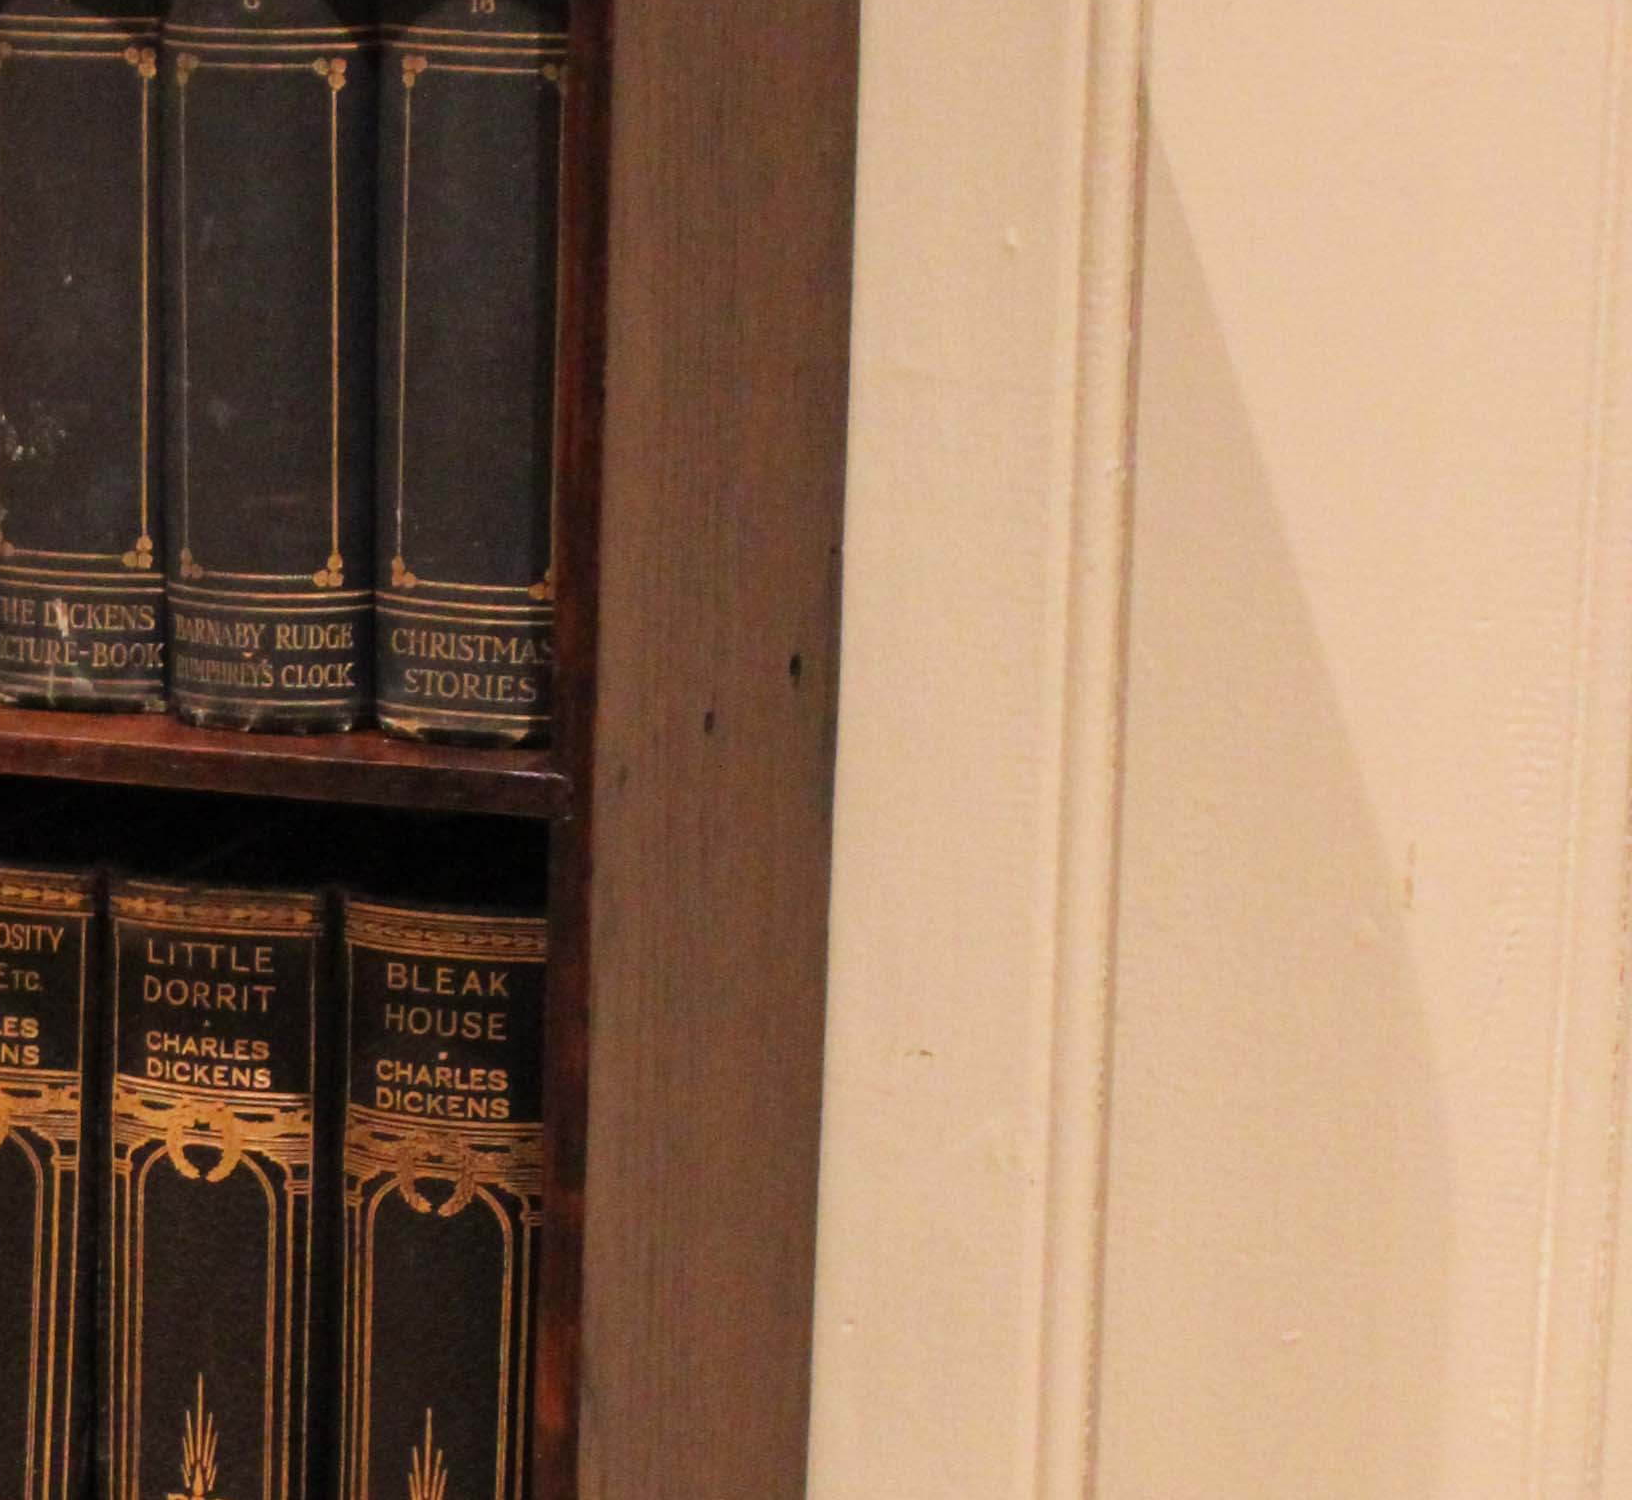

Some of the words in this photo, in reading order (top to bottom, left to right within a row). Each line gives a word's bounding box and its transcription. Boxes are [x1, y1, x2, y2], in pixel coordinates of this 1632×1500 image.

[43, 599, 156, 631] DICKENS
[175, 614, 265, 650] BARNABY
[275, 623, 354, 651] RUDGE
[280, 662, 355, 688] CLOCK
[405, 668, 536, 702] STORIES
[146, 939, 275, 973] LITTLE
[143, 974, 277, 1013] DORRIT
[386, 961, 510, 997] BLEAK
[384, 1003, 507, 1041] HOUSE
[145, 1030, 270, 1061] CHARLES
[146, 1056, 272, 1090] DICKENS
[376, 1059, 509, 1092] CHARLES
[375, 1086, 510, 1119] DICKENS
